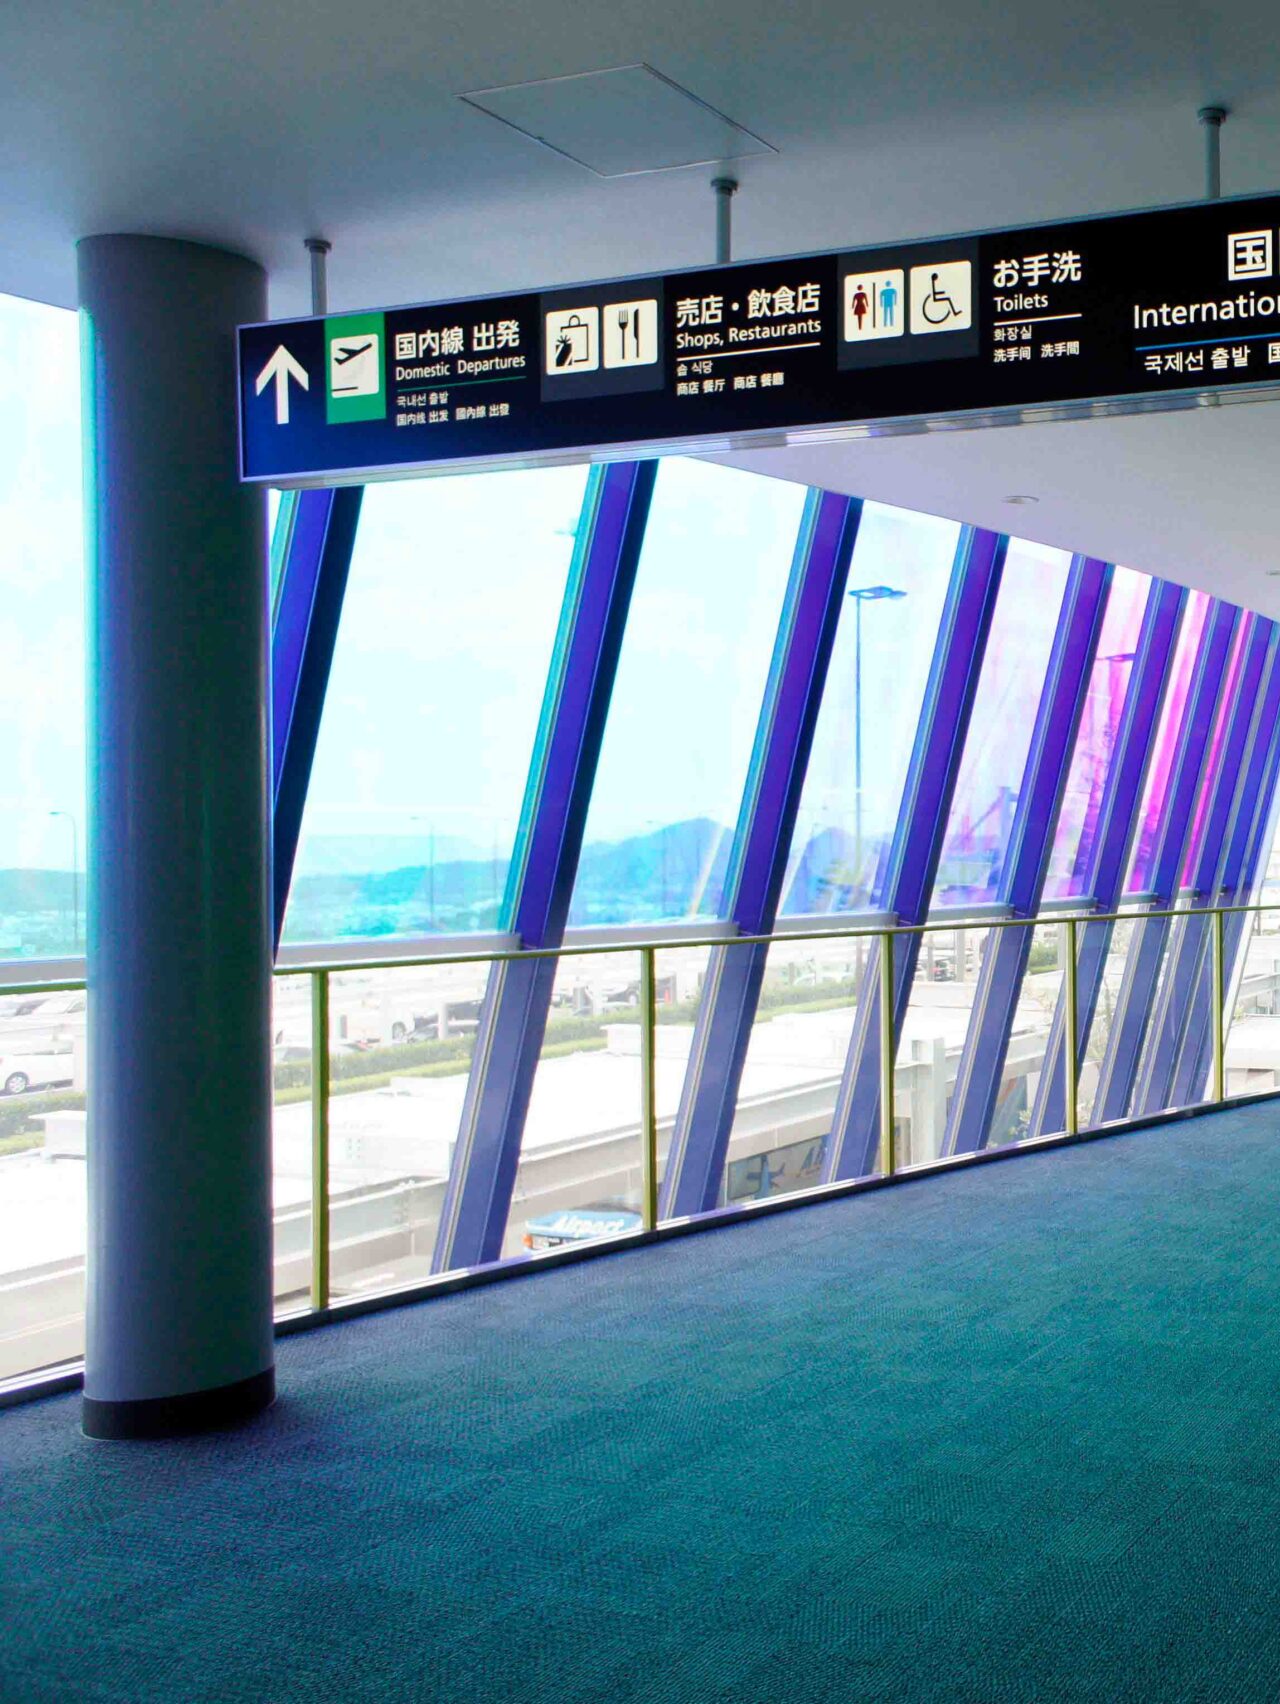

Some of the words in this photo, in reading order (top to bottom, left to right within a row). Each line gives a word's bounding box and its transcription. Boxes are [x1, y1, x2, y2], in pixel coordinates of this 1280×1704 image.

[993, 251, 1082, 288] お手洗
[677, 283, 820, 329] 売店・飲食店
[994, 293, 1048, 313] Toilets
[395, 326, 464, 361] 国内線
[473, 320, 519, 351] 出発
[676, 332, 723, 350] Shops,
[729, 319, 821, 342] Restaurants
[993, 325, 1032, 342] 화장실
[993, 346, 1031, 363] 洗手间
[1041, 341, 1079, 358] 洗手間
[1144, 350, 1203, 375] 국제선
[1211, 345, 1250, 369] 출발
[396, 362, 450, 381] Domestic
[457, 355, 526, 376] Departures
[692, 359, 713, 374] 식당
[677, 381, 699, 396] 商店
[703, 379, 725, 393] 餐厅
[734, 375, 757, 390] 商店
[397, 393, 426, 408] 국내선
[429, 410, 448, 423] 出发
